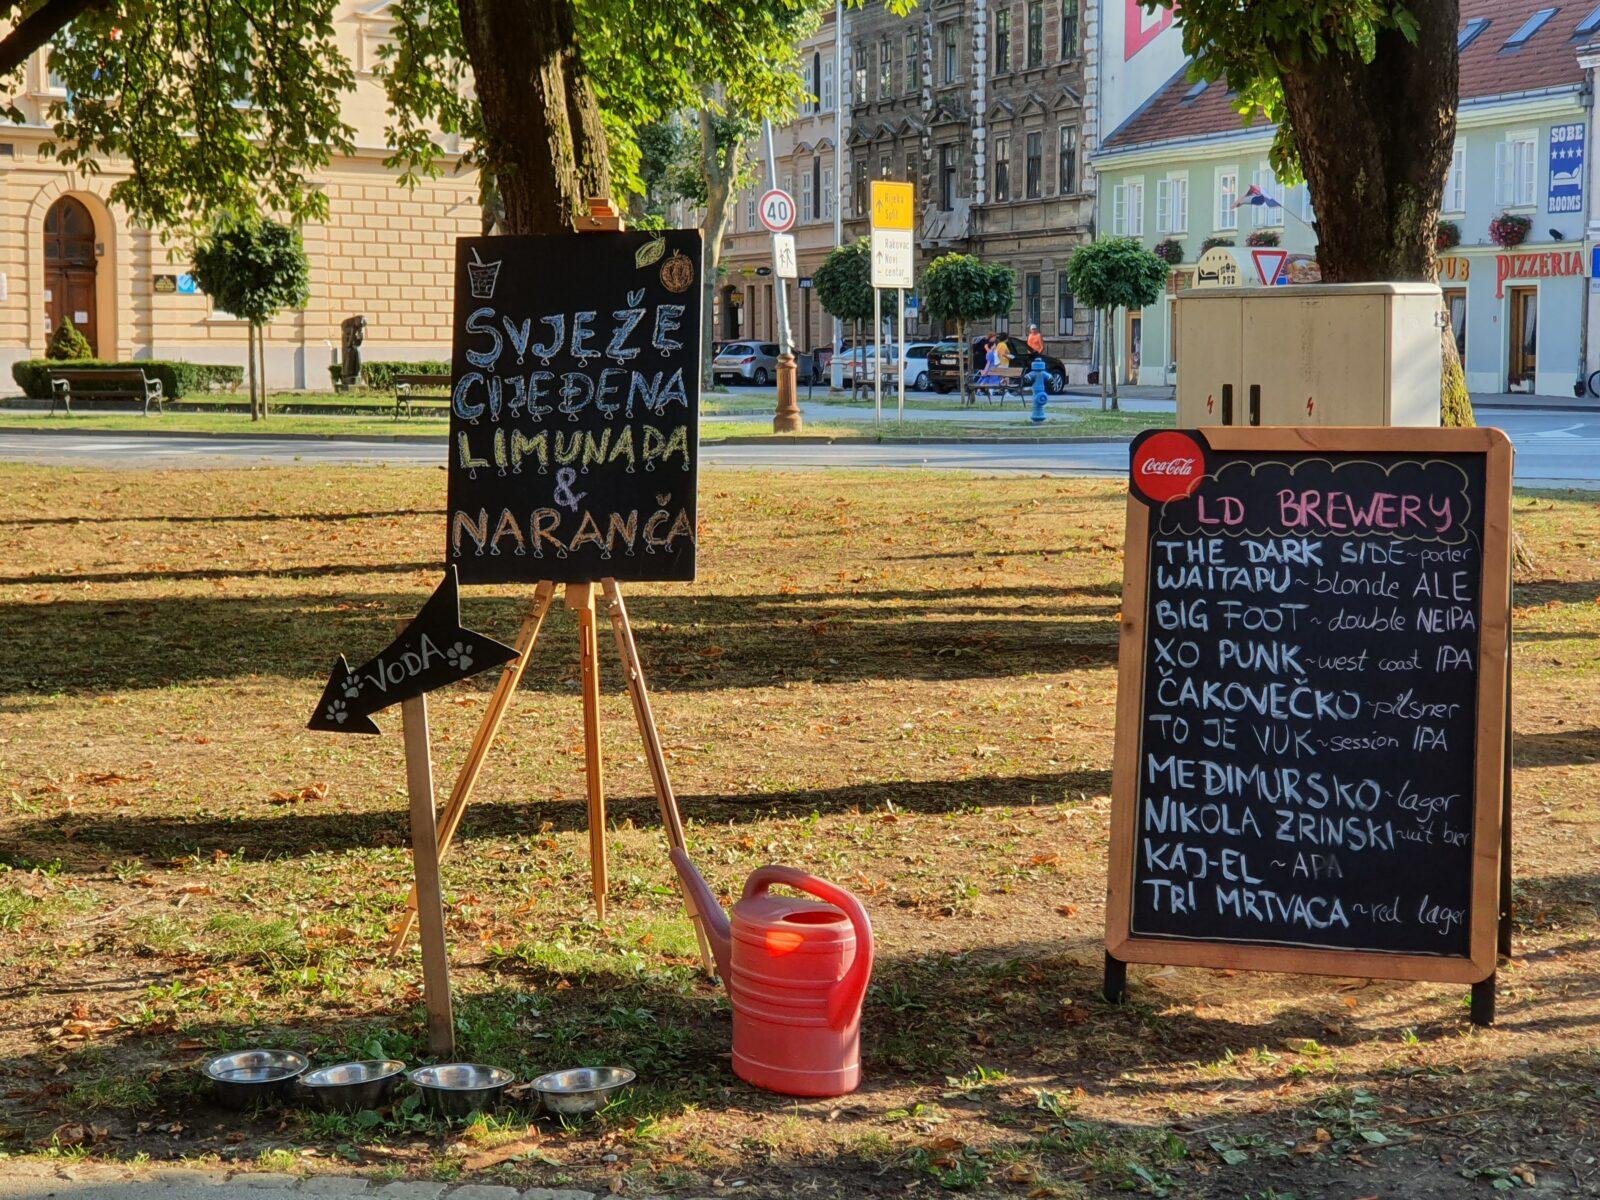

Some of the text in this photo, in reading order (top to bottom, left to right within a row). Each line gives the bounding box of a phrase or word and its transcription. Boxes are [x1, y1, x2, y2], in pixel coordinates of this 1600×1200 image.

[1551, 125, 1583, 143] SOBE
[767, 201, 788, 220] 40
[884, 192, 905, 206] Rijeka
[885, 209, 898, 221] Split
[1549, 195, 1581, 211] ROOMS
[884, 239, 909, 250] Rakovac
[884, 254, 898, 264] Novi
[884, 267, 904, 277] centar
[1496, 251, 1584, 299] PIZZERIA
[465, 288, 686, 370] SVJEŽE
[452, 367, 688, 422] CIJEĐENA
[458, 425, 689, 474] LIMUNADA
[553, 467, 588, 512] &
[1198, 489, 1453, 532] LD BREWERY
[452, 492, 696, 557] NARANČA
[1156, 538, 1226, 565] THE
[1240, 538, 1324, 567] DARK
[1340, 540, 1407, 565] SIDE
[1420, 544, 1473, 569] porter
[1157, 565, 1291, 593] WAITAPU
[1313, 568, 1400, 599] blonde
[1412, 571, 1472, 601] ALE
[1155, 599, 1209, 632] BIG
[1217, 600, 1310, 632] FOOT
[1328, 606, 1406, 632] double
[1416, 606, 1475, 633] NEIPA
[364, 633, 447, 692] VODA
[1154, 637, 1199, 668] XO
[1218, 638, 1307, 675] PUNK
[1318, 649, 1369, 672] west
[1378, 649, 1423, 672] coast
[1435, 645, 1473, 673] IPA
[1157, 665, 1360, 720] ČAKOVEČKO
[1373, 688, 1460, 720] pilsner
[1148, 714, 1189, 744] TO
[1202, 717, 1238, 750] JE
[1251, 723, 1318, 759] VUK
[1330, 730, 1400, 752] session
[1413, 724, 1448, 752] IPA
[1397, 779, 1461, 823] lager
[1144, 795, 1262, 838] NIKOLA
[1275, 809, 1395, 851] ZRINSKI
[1143, 837, 1265, 885] KAJ-EL
[1292, 851, 1344, 880] APA
[1142, 879, 1197, 914] TRI
[1215, 883, 1350, 929] MRTVACA
[1371, 895, 1403, 923] red
[1417, 893, 1467, 936] lager
